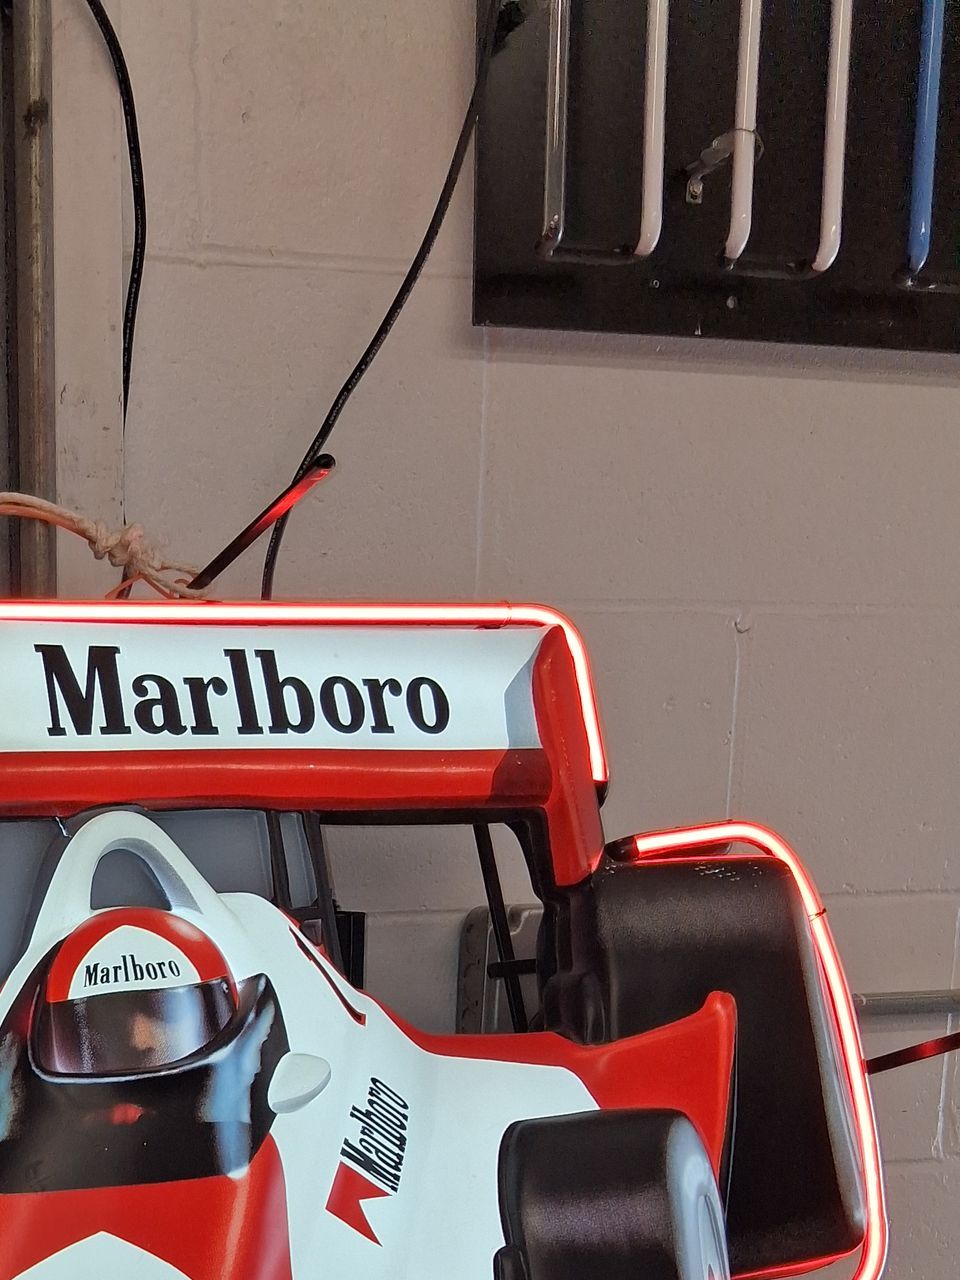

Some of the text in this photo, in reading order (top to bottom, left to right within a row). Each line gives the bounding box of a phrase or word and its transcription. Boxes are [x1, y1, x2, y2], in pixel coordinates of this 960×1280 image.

[34, 643, 450, 736] Marlboro
[83, 954, 181, 988] Marlboro
[340, 1077, 409, 1193] Marlboro
